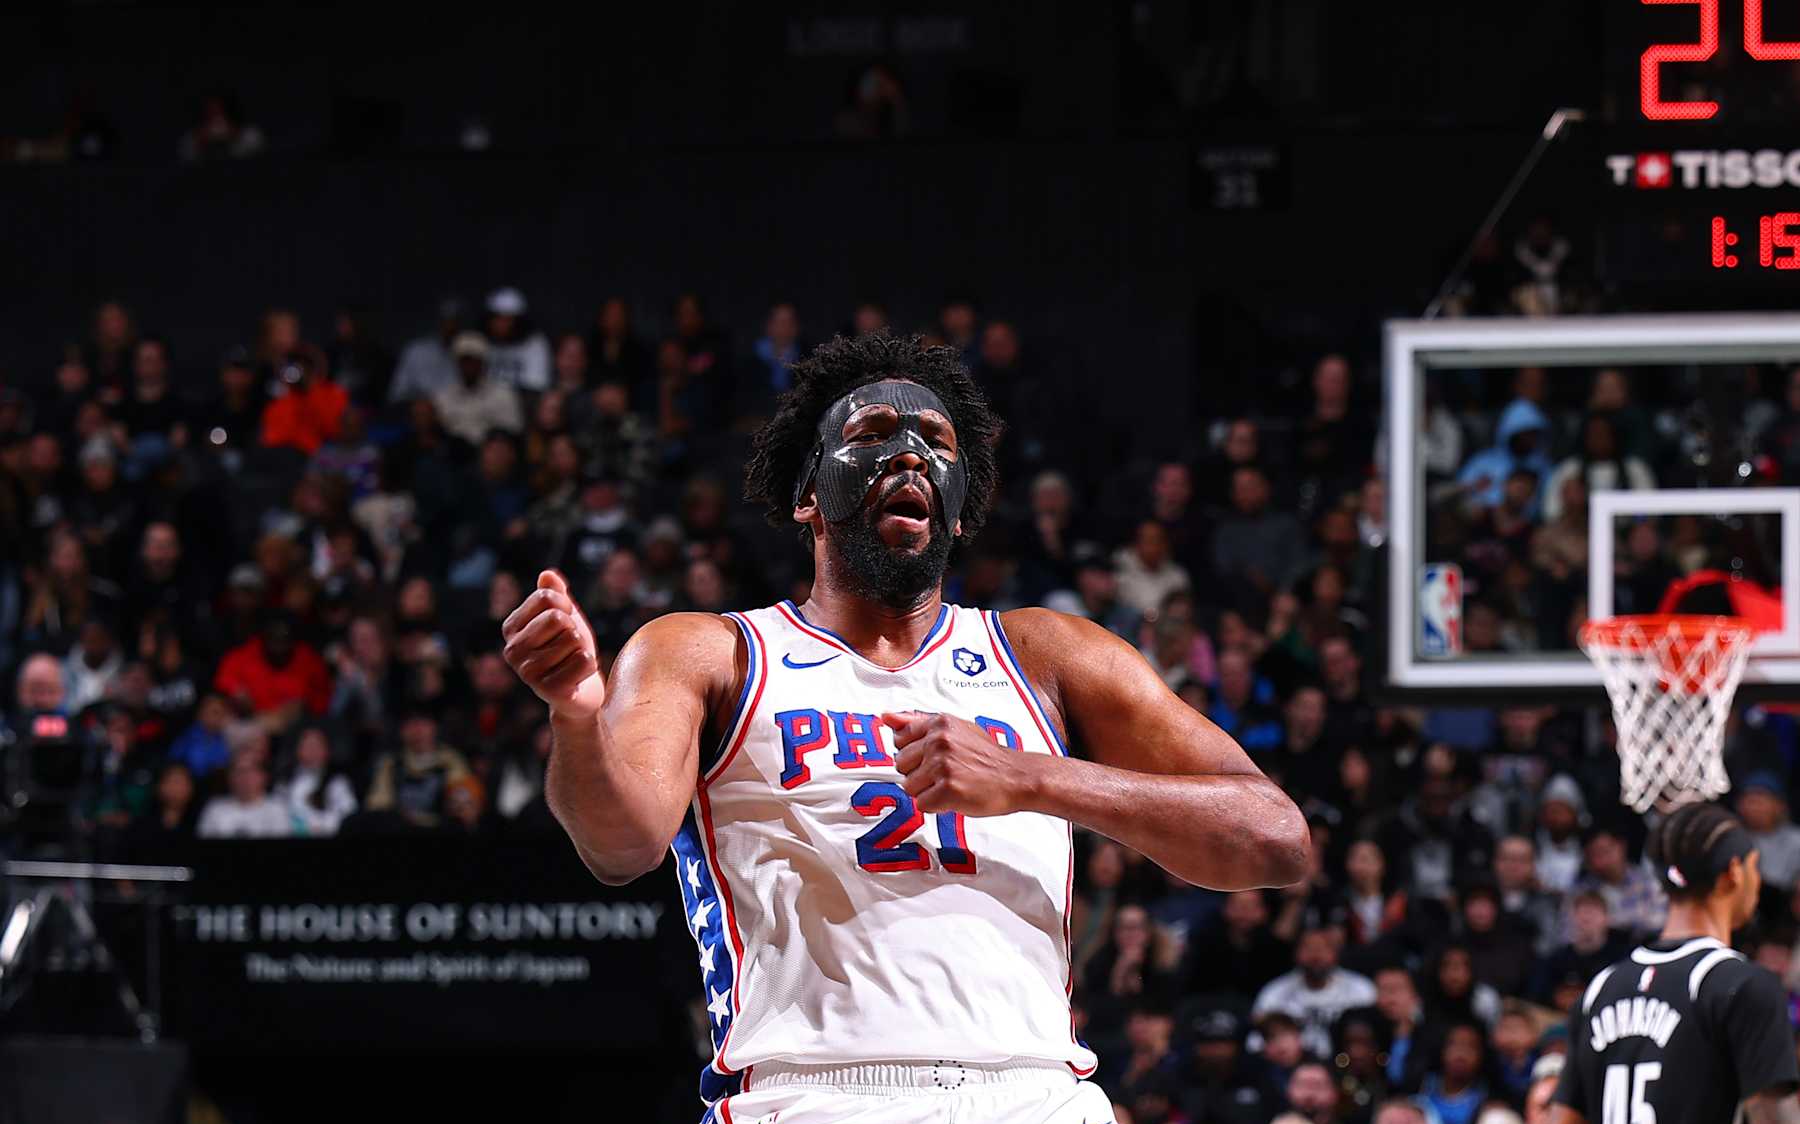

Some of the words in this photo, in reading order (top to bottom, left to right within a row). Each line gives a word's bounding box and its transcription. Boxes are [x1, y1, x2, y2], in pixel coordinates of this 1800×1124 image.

[850, 781, 977, 874] 21
[259, 903, 399, 941] HOUSE
[404, 903, 460, 941] OF
[467, 903, 666, 941] SUNTORY
[1590, 995, 1682, 1052] JOHNSON
